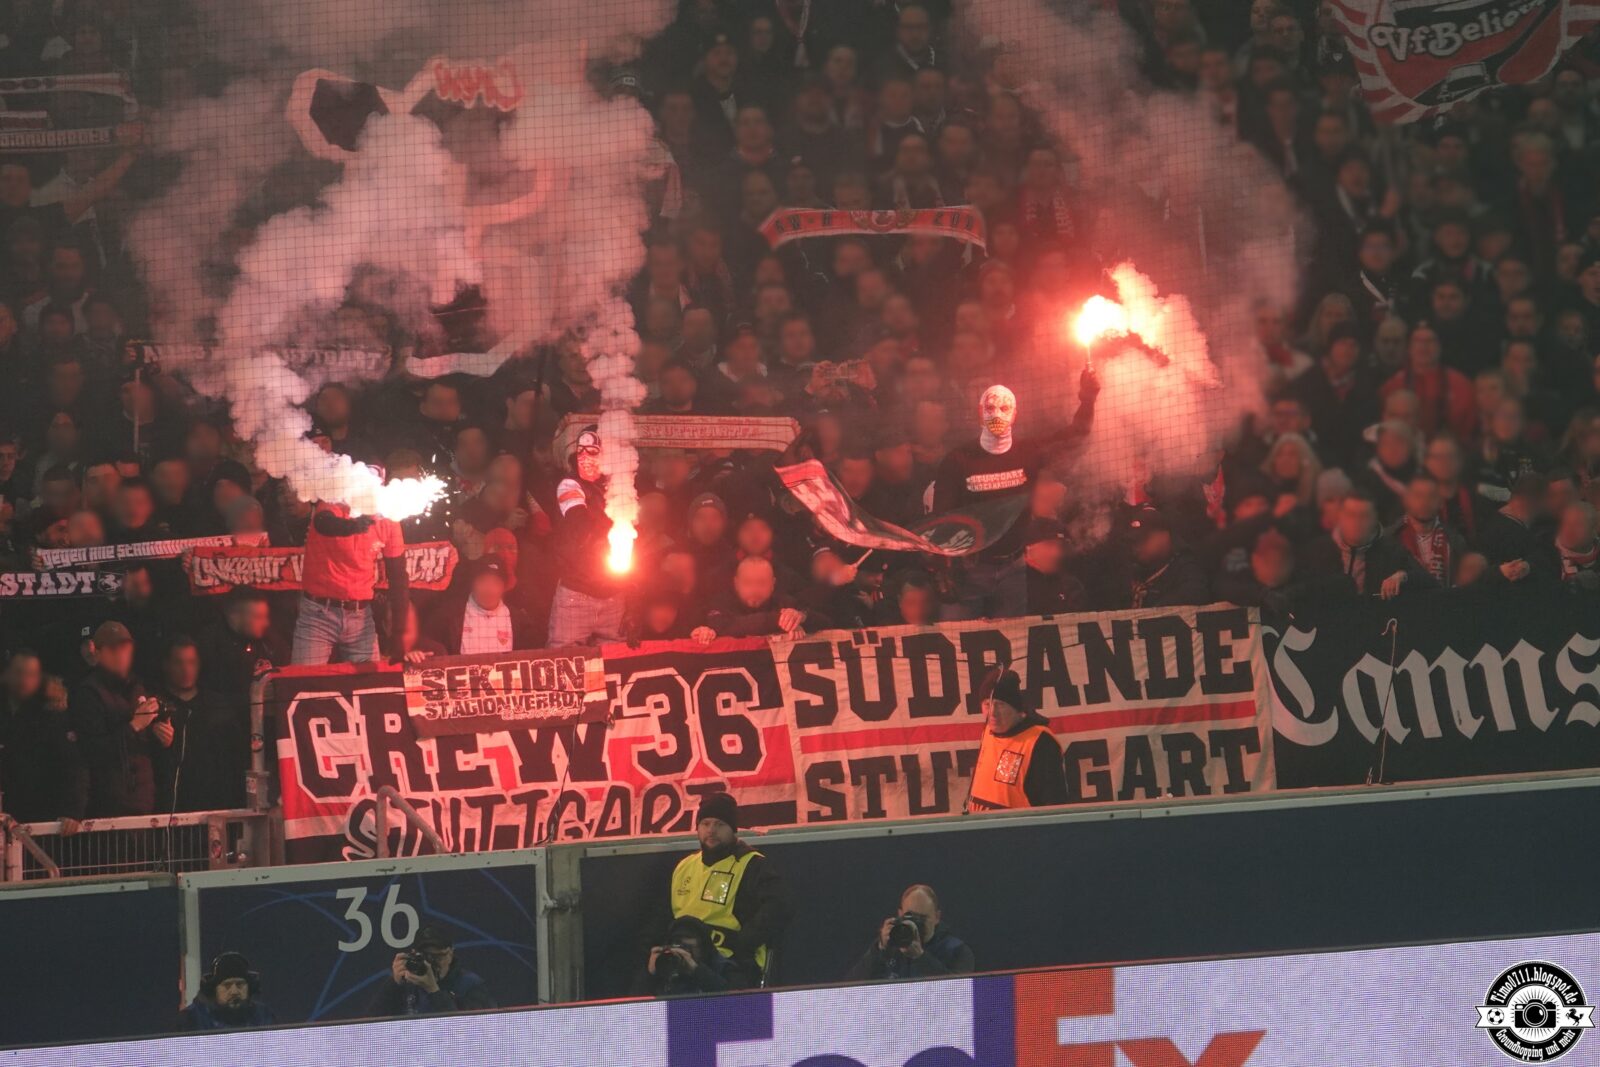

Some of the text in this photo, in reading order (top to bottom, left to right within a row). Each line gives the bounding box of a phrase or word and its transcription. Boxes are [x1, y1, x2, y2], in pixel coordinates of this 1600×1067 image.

[421, 656, 586, 702] SEKTION
[288, 668, 767, 802] CREW 36
[804, 727, 1262, 823] STUGART
[335, 883, 420, 953] 36
